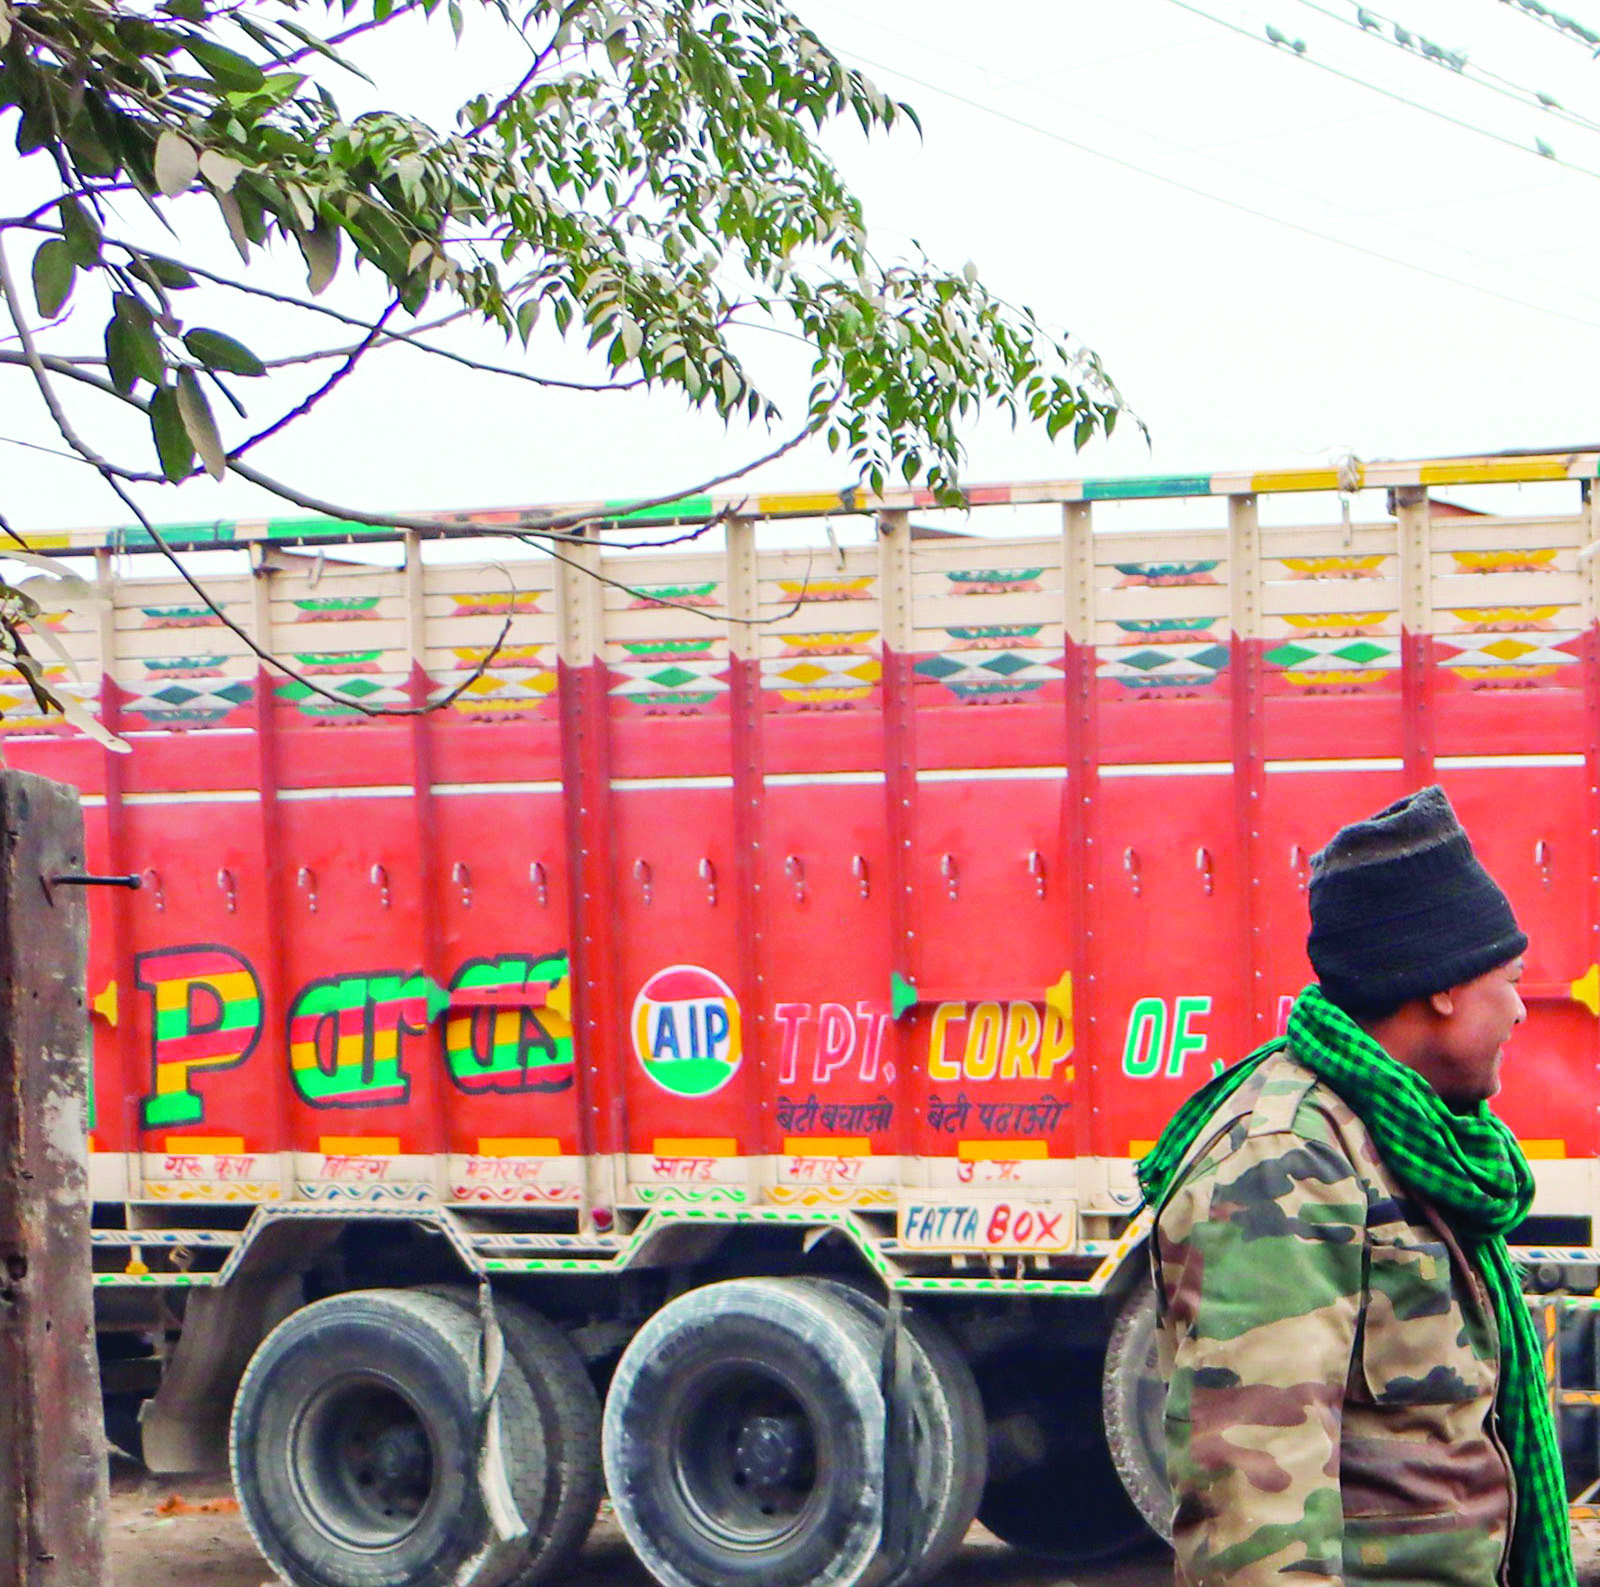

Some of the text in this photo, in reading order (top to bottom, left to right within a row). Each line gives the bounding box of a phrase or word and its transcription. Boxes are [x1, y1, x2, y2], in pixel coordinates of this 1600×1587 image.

[652, 1003, 730, 1060] AIP
[904, 1203, 1064, 1245] FATTA BOX
